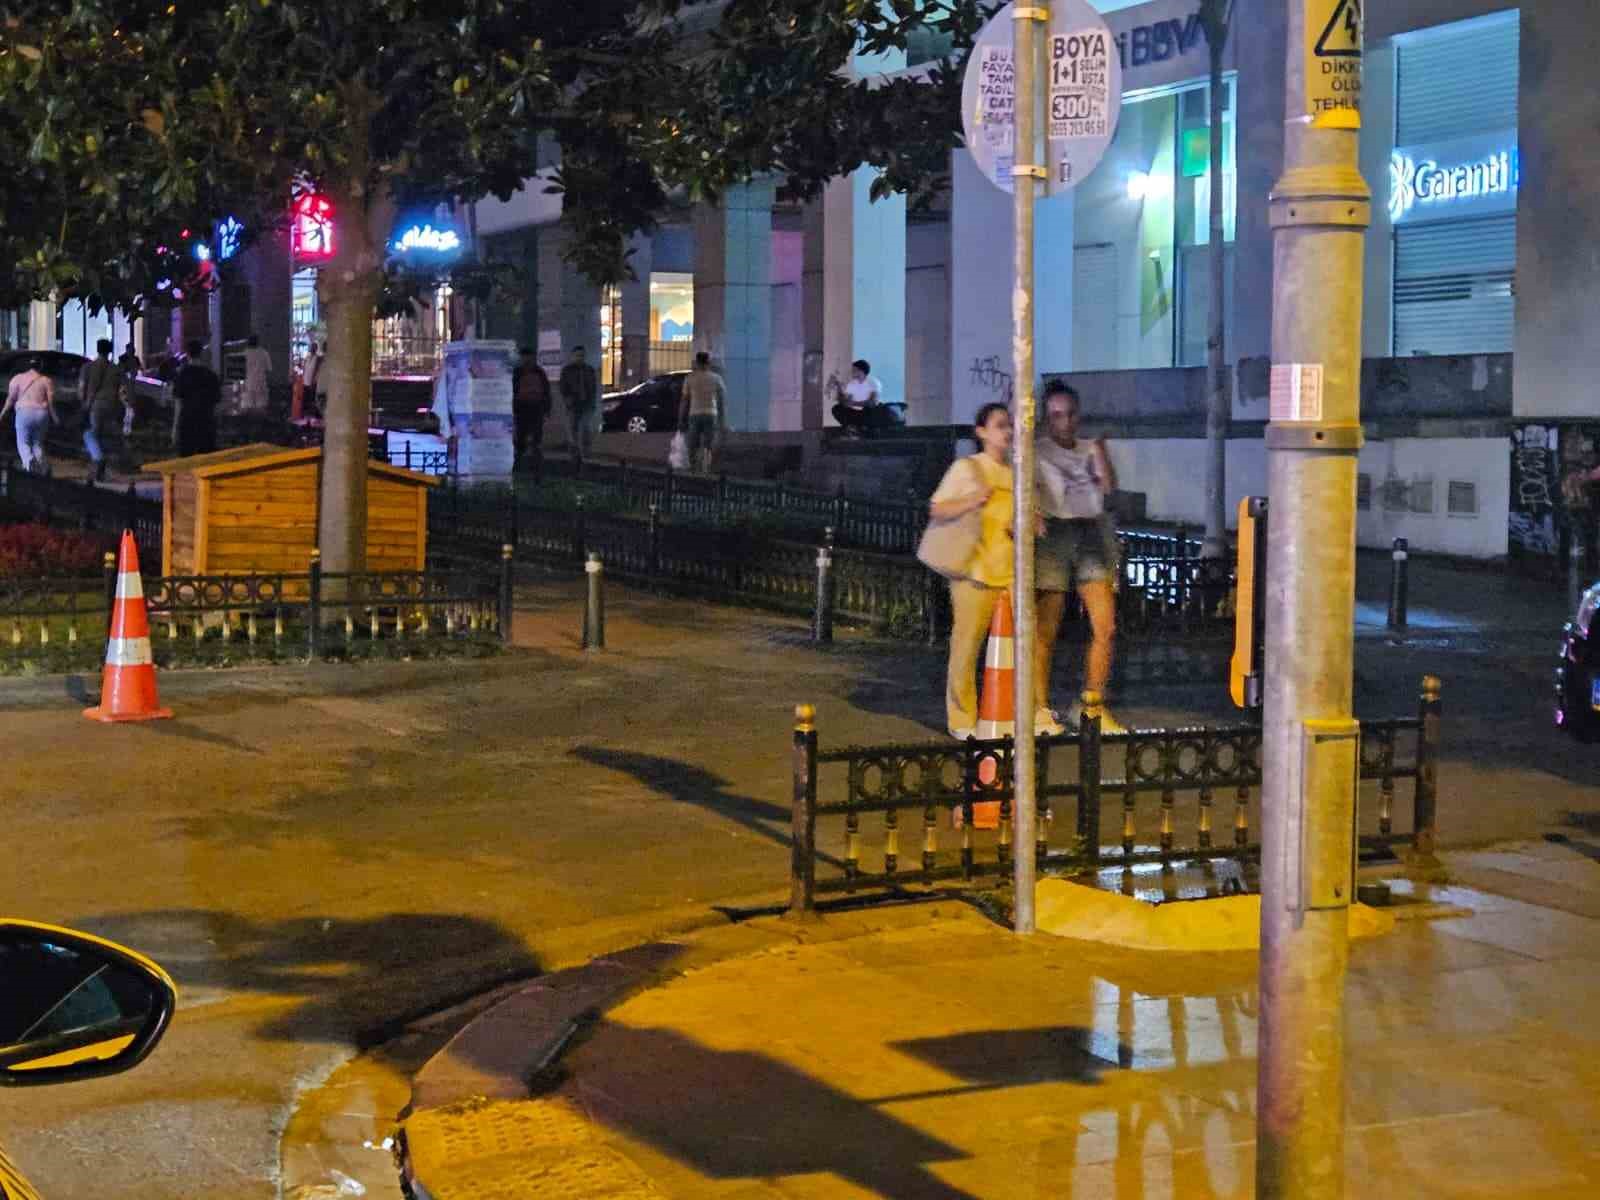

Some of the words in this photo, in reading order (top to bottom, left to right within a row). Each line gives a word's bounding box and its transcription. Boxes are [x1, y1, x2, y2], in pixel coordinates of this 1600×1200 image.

[1053, 34, 1105, 59] BOYA
[1053, 60, 1077, 84] 1+1
[1053, 95, 1089, 119] 300
[1413, 151, 1508, 200] Garanti
